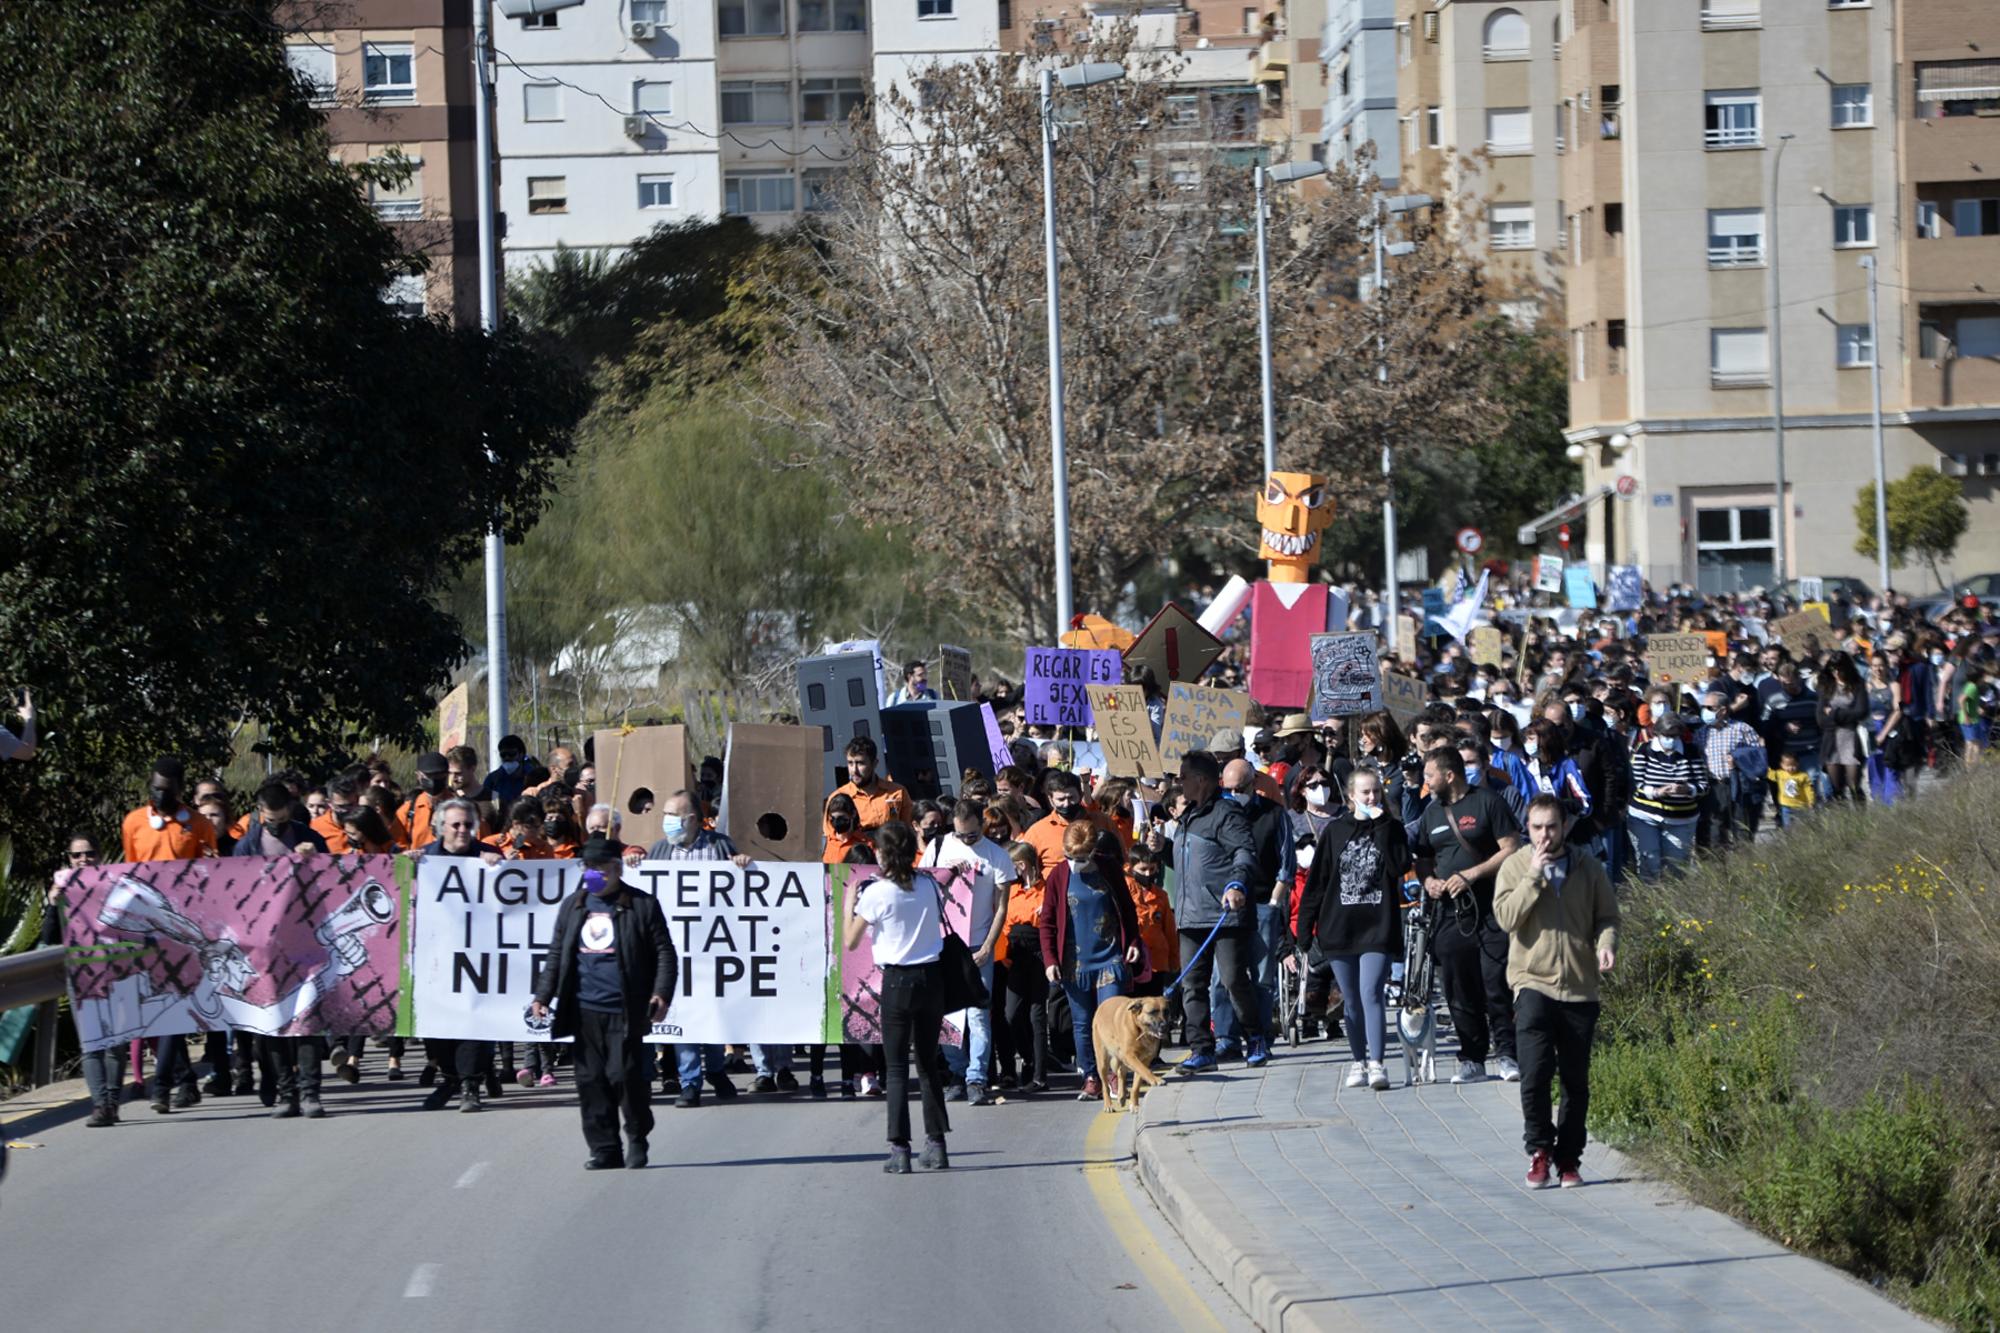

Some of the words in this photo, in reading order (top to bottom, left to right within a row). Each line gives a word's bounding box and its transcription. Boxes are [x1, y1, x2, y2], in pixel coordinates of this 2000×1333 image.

[1033, 654, 1080, 679] REGAR
[1091, 653, 1110, 681] ÉS
[1173, 686, 1234, 708] AIGUA
[1034, 703, 1048, 720] EL
[1110, 712, 1137, 736] ÉS
[1106, 738, 1152, 761] VIDA
[640, 870, 810, 907] TERRA
[465, 911, 472, 948] I
[453, 952, 508, 994] NI
[715, 956, 777, 997] PE
